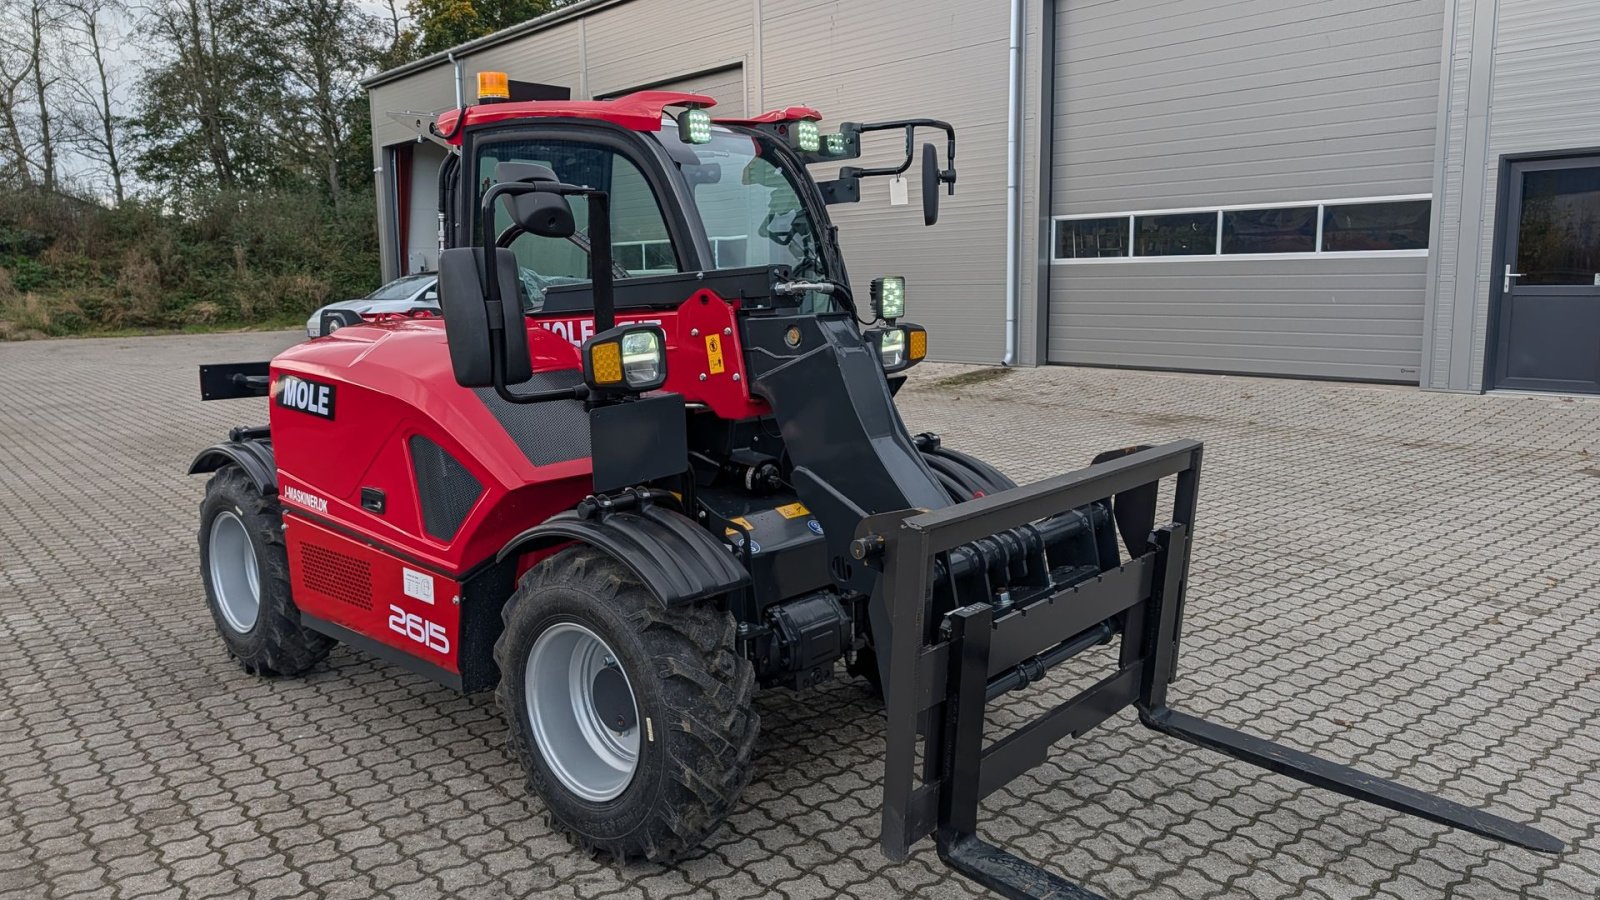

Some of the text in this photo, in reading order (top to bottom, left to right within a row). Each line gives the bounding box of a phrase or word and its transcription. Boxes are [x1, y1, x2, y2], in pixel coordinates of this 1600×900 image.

[543, 320, 593, 347] OLE
[283, 378, 330, 416] MOLE
[388, 603, 450, 654] 2615
